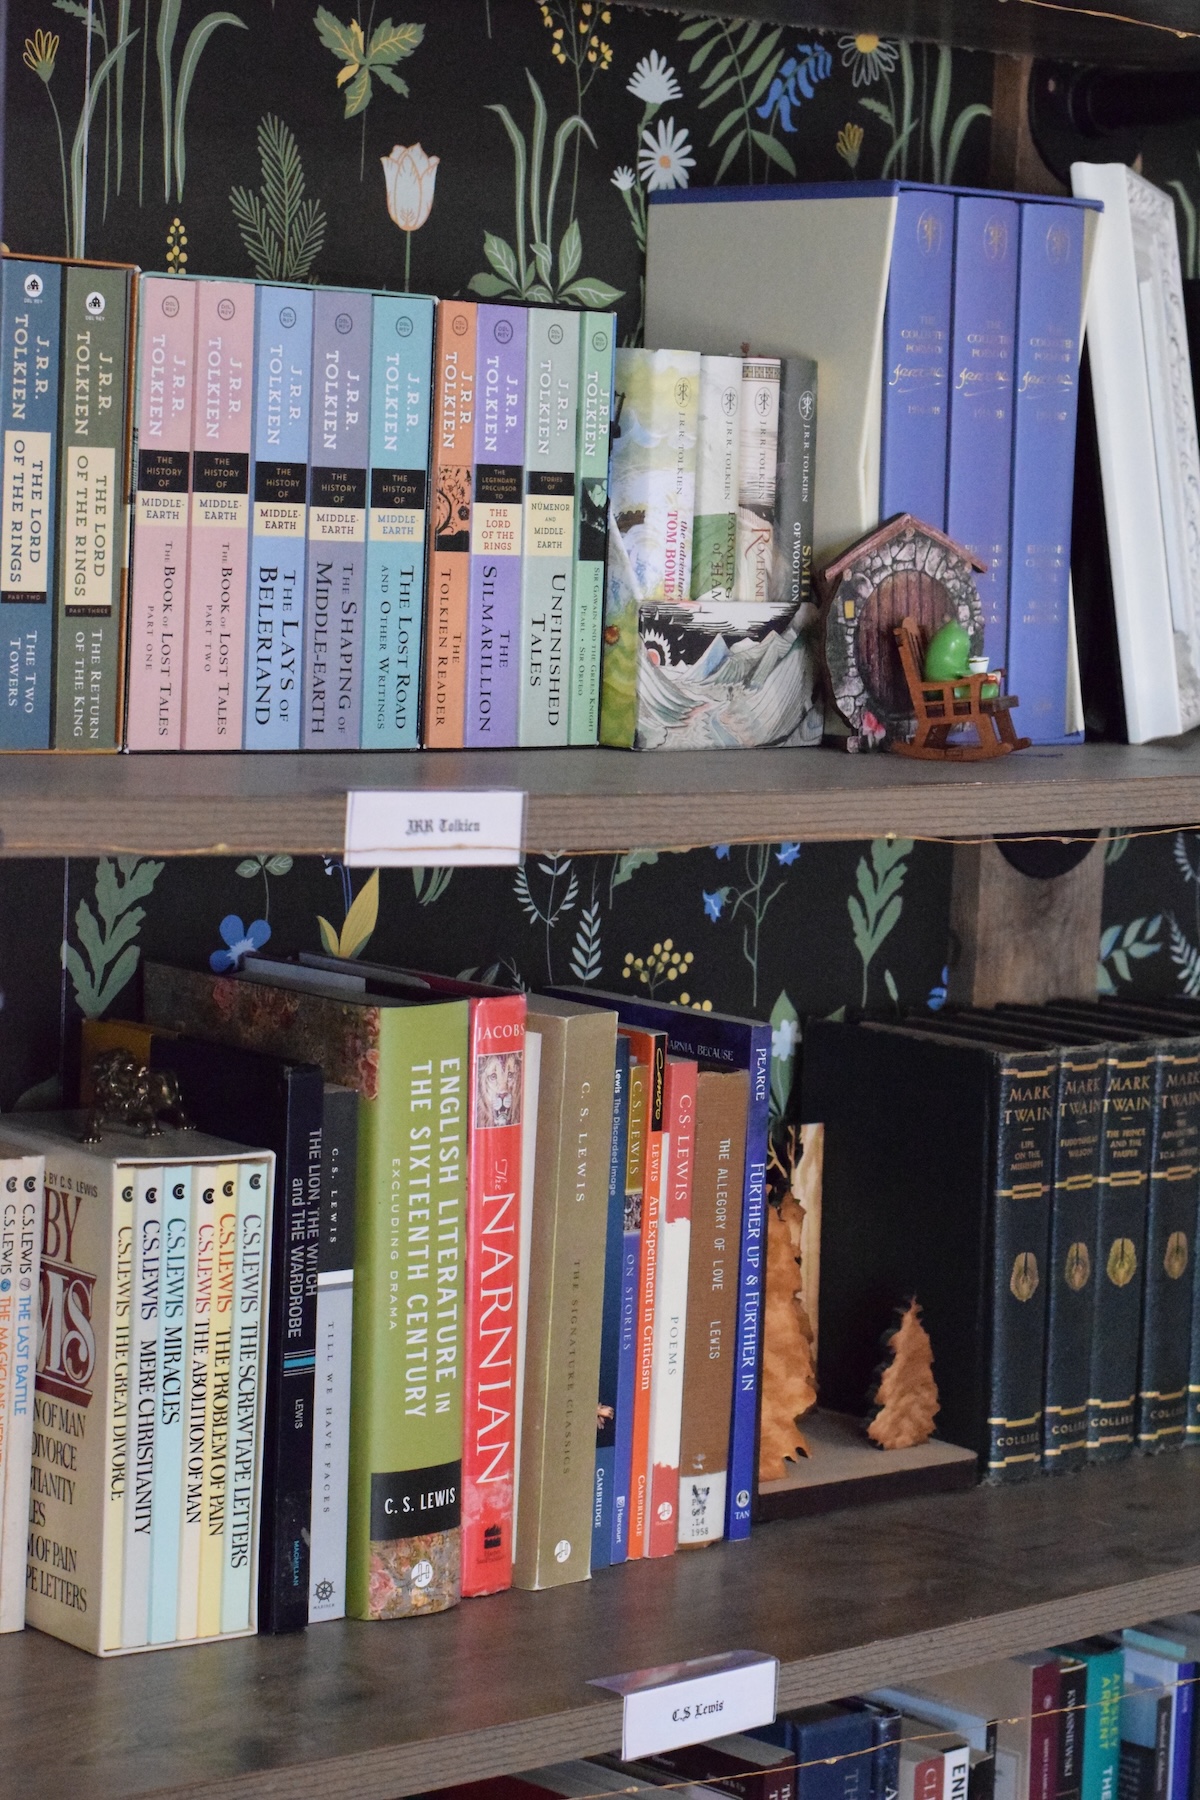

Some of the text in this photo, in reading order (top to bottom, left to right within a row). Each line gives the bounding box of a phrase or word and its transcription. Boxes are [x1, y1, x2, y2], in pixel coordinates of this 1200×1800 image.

[12, 314, 28, 419] TOLKIEN
[35, 336, 49, 399] J.R.R.
[74, 331, 90, 436] TOLKIEN
[98, 353, 113, 416] J.R.R.
[141, 498, 185, 508] MIDDLE-
[147, 467, 182, 476] HISTORY
[531, 501, 570, 511] NÚMENOR
[10, 440, 26, 583] OF THE RINGS
[30, 461, 43, 563] THE LORD
[94, 476, 107, 577] THE LORD
[146, 510, 180, 520] EARTH
[482, 531, 514, 540] OF THE
[483, 542, 512, 550] RINGS
[486, 520, 511, 529] LORD
[489, 509, 508, 518] THE
[537, 541, 563, 549] EARTH
[678, 542, 687, 601] adventure
[8, 637, 21, 707] TOWERS
[24, 630, 38, 713] THE TWO
[158, 540, 175, 736] THE BOOK OF LOST TALES
[255, 566, 278, 726] BELERIAND
[279, 570, 299, 722] THE LAYS OF
[311, 561, 333, 734] MIDDLE-EARTH
[337, 563, 357, 734] THE SHAPING OF
[377, 565, 392, 730] AND OTHER WRITINGS
[395, 566, 414, 729] THE LOST ROAD
[436, 568, 452, 726] TOLKIEN READER
[452, 632, 462, 664] THE
[479, 565, 498, 733] SILMARILLION
[499, 631, 511, 669] THE
[529, 613, 546, 687] TALES
[548, 574, 566, 727] UNFINISHED
[73, 631, 85, 737] OF THE KING
[89, 629, 103, 739] THE RETURN
[405, 818, 480, 835] JRR Tolkien
[477, 1024, 526, 1042] JACOBS
[669, 1040, 734, 1061] ARNIA, BECAUSE
[613, 1099, 622, 1114] The
[755, 1048, 766, 1101] PEARCE
[1009, 1085, 1052, 1102] MARK
[1060, 1099, 1100, 1117] TWAIN
[1065, 1078, 1100, 1095] MARK
[1103, 1097, 1150, 1113] TWAIN
[1108, 1076, 1150, 1092] MARK
[611, 1117, 621, 1163] Discarded
[1004, 1107, 1052, 1125] TWAIN
[494, 1159, 508, 1190] The
[609, 1166, 618, 1196] Image
[43, 1186, 82, 1264] BY
[306, 1128, 322, 1297] THE LION, THE WITCH
[389, 1158, 401, 1330] EXCLUDING DRAMA
[405, 1060, 432, 1417] THE SIXTEENTH CENTURY
[435, 1057, 461, 1413] ENGLISH LITERATURE IN
[709, 1138, 730, 1359] THE ALLEGORY OF LOVE LEWIS
[288, 1178, 305, 1339] and THE WARDROBE
[641, 1143, 660, 1391] LEWIS An Experiment in Criticism
[741, 1163, 765, 1391] FURTHER UP & FURTHER IN
[476, 1192, 516, 1484] NARNIAN
[623, 1254, 635, 1350] ON STORIES
[14, 1295, 32, 1415] THE LAST BATTLE
[162, 1327, 183, 1425] MIRACLES
[668, 1316, 679, 1376] POEMS
[42, 1401, 86, 1439] OF MAN
[111, 1327, 129, 1500] THE GREAT DIVORCE
[134, 1340, 157, 1535] MERE CHRISTIANITY
[186, 1320, 210, 1523] THE ABOLITION OF MAN
[208, 1327, 231, 1537] THE PROBLEM OF PAIN
[231, 1321, 258, 1569] THE SCREWTAPE LETTERS
[294, 1399, 304, 1430] LEWIS
[323, 1321, 335, 1513] TILL WE HAVE FACES
[595, 1468, 605, 1528] CAMBRIDGE
[691, 1527, 709, 1536] 1958
[734, 1510, 750, 1520] TAN
[40, 1570, 87, 1613] LETTERS
[694, 1700, 725, 1719] Lewis
